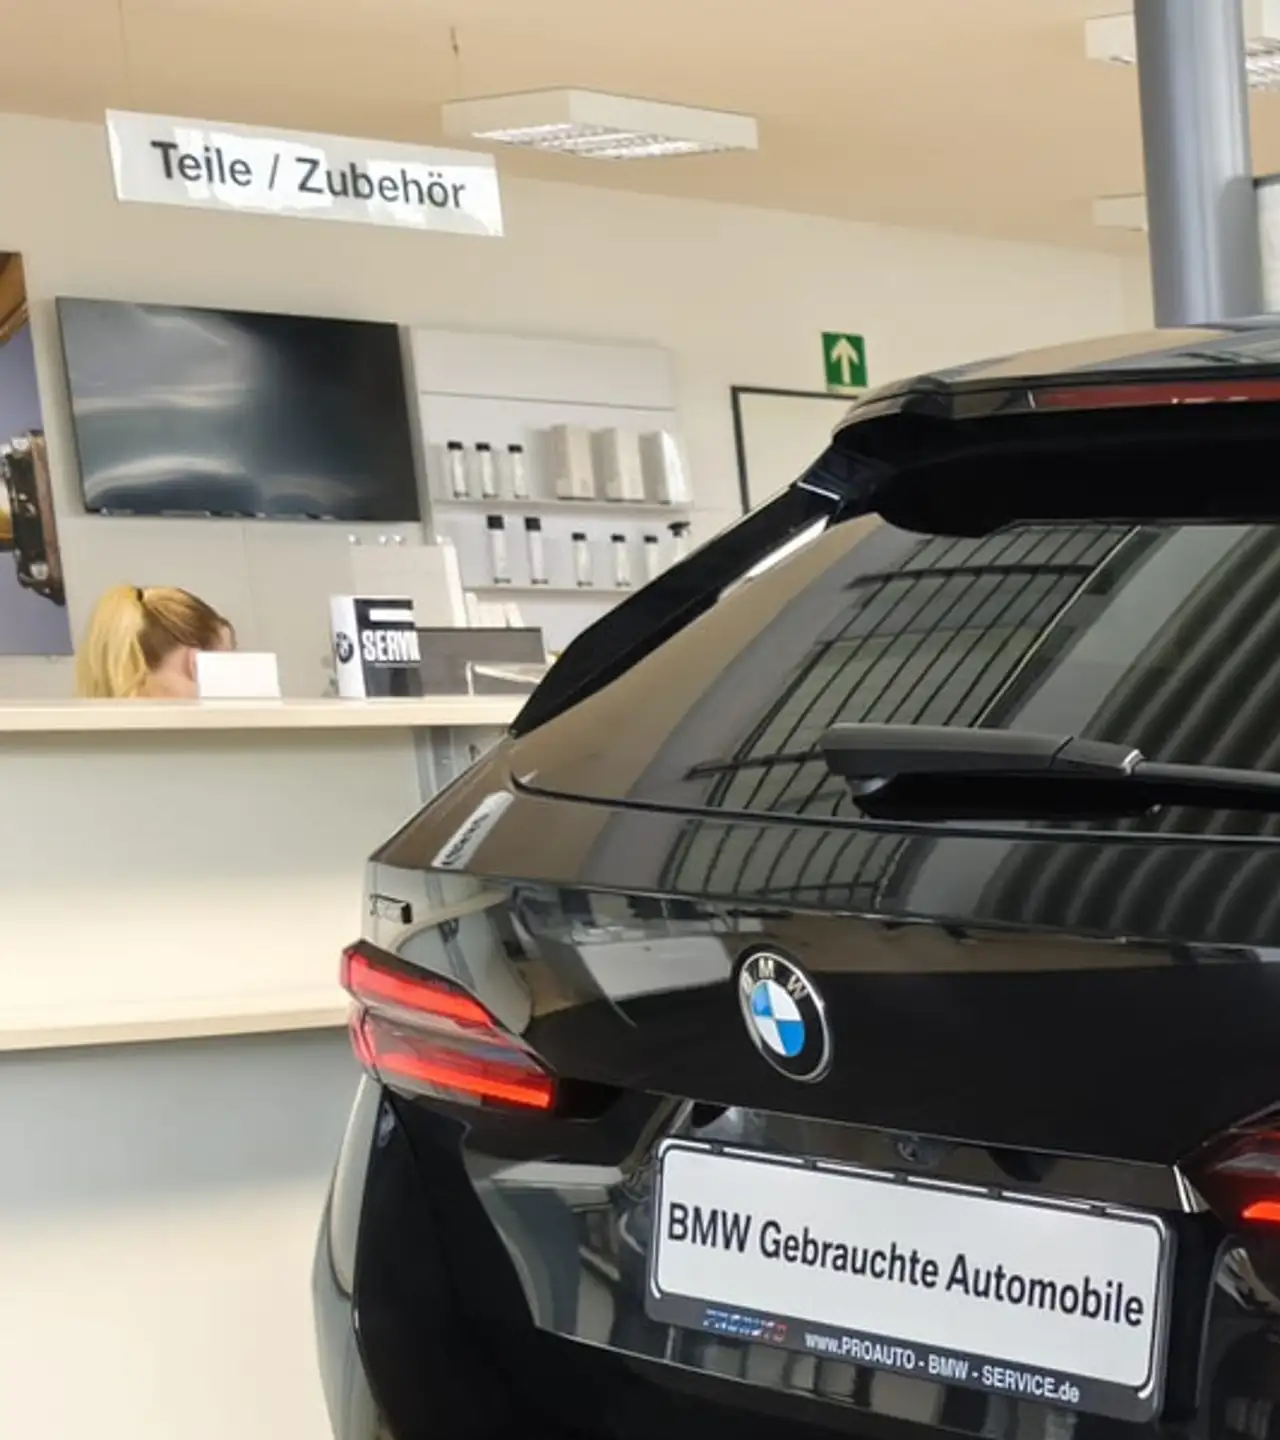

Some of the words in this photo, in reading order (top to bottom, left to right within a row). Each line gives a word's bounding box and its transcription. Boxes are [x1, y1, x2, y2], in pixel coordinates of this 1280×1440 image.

[150, 139, 253, 187] Teile
[268, 153, 280, 191] /
[294, 156, 466, 209] Zubehör
[667, 1201, 752, 1253] BMW
[759, 1219, 939, 1291] Gebrauchte
[945, 1253, 1145, 1327] Automobile
